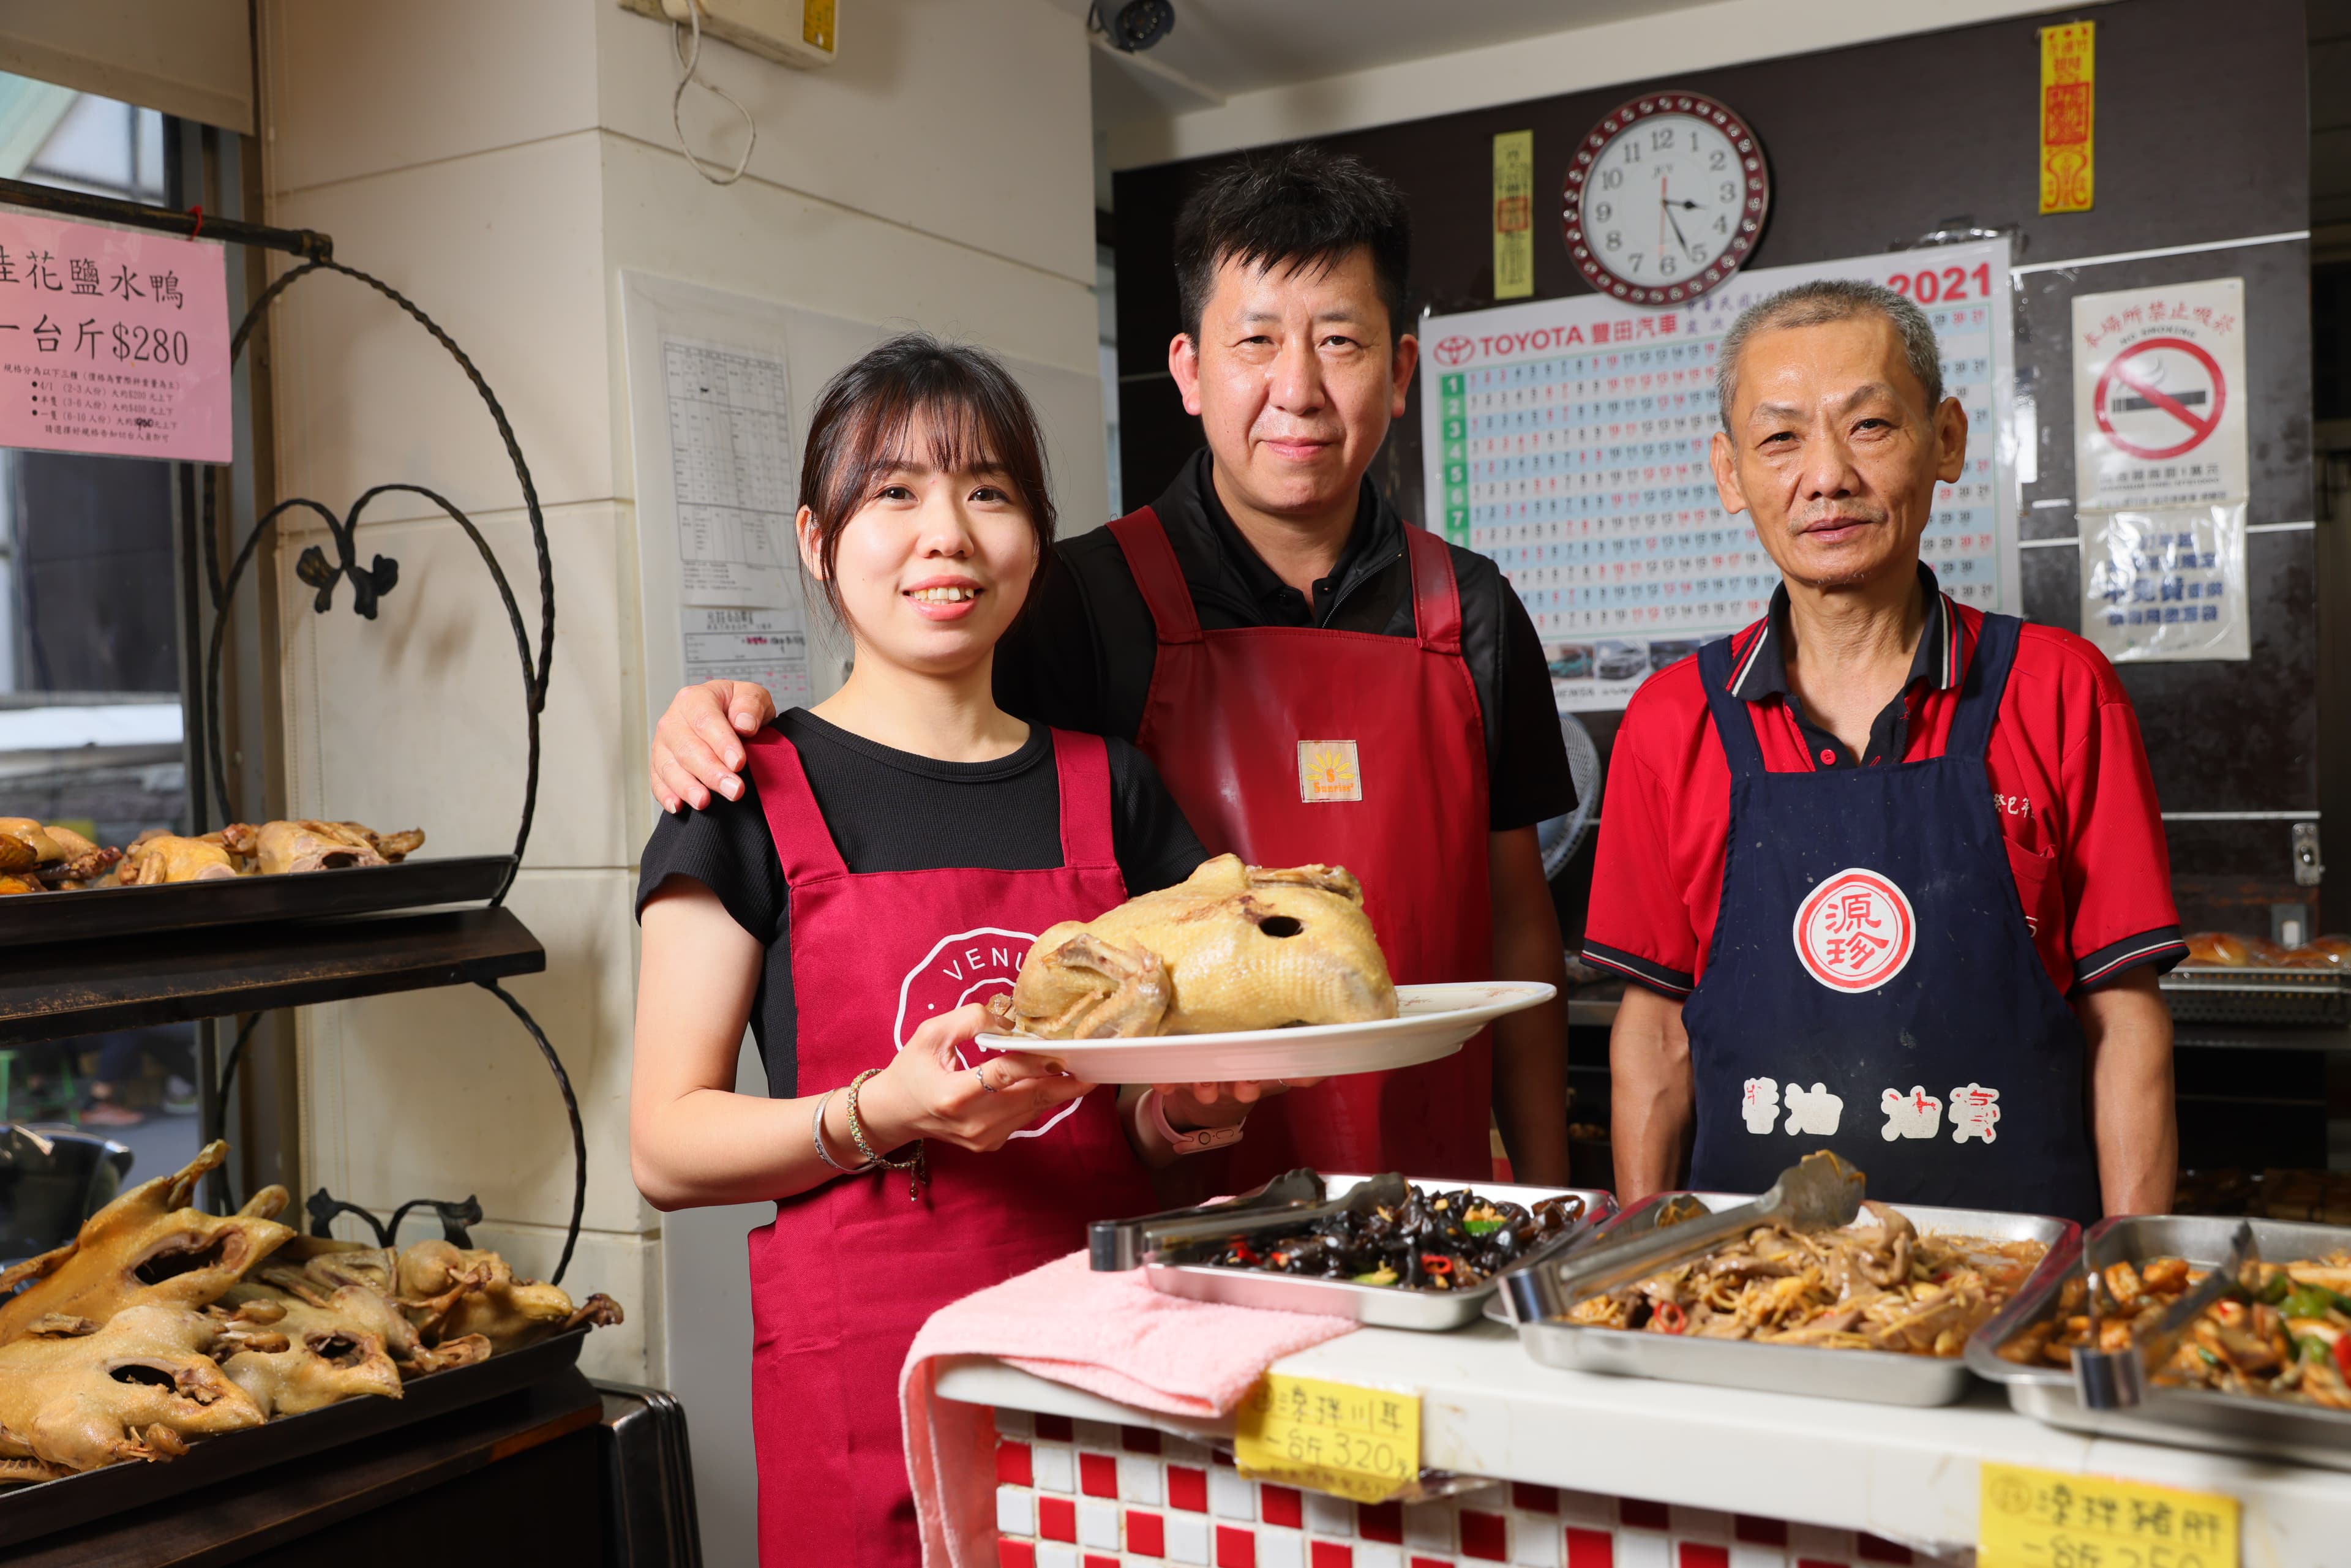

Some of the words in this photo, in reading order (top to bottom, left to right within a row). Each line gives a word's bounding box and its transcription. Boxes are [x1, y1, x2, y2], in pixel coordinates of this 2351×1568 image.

[1651, 128, 1674, 151] 12
[1690, 132, 1698, 151] 1
[1624, 141, 1640, 163] 11
[1709, 149, 1726, 171] 2
[1602, 168, 1623, 190] 10
[1719, 181, 1736, 203] 3
[1595, 201, 1612, 222] 9
[1712, 214, 1727, 234] 4
[1605, 230, 1622, 252] 8
[1628, 252, 1644, 272] 7
[1691, 243, 1707, 264] 5
[1659, 255, 1676, 277] 6
[1888, 262, 1990, 304] 2021
[1479, 325, 1584, 357] TOYOTA
[1592, 314, 1677, 345] 豐田汽車
[1448, 377, 1458, 392] 1
[1449, 399, 1460, 415] 2
[1449, 422, 1461, 438] 3
[1449, 443, 1461, 459] 4
[1450, 465, 1462, 482] 5
[1452, 489, 1463, 505] 6
[1452, 511, 1464, 526] 7
[1824, 892, 1889, 969] 源珍
